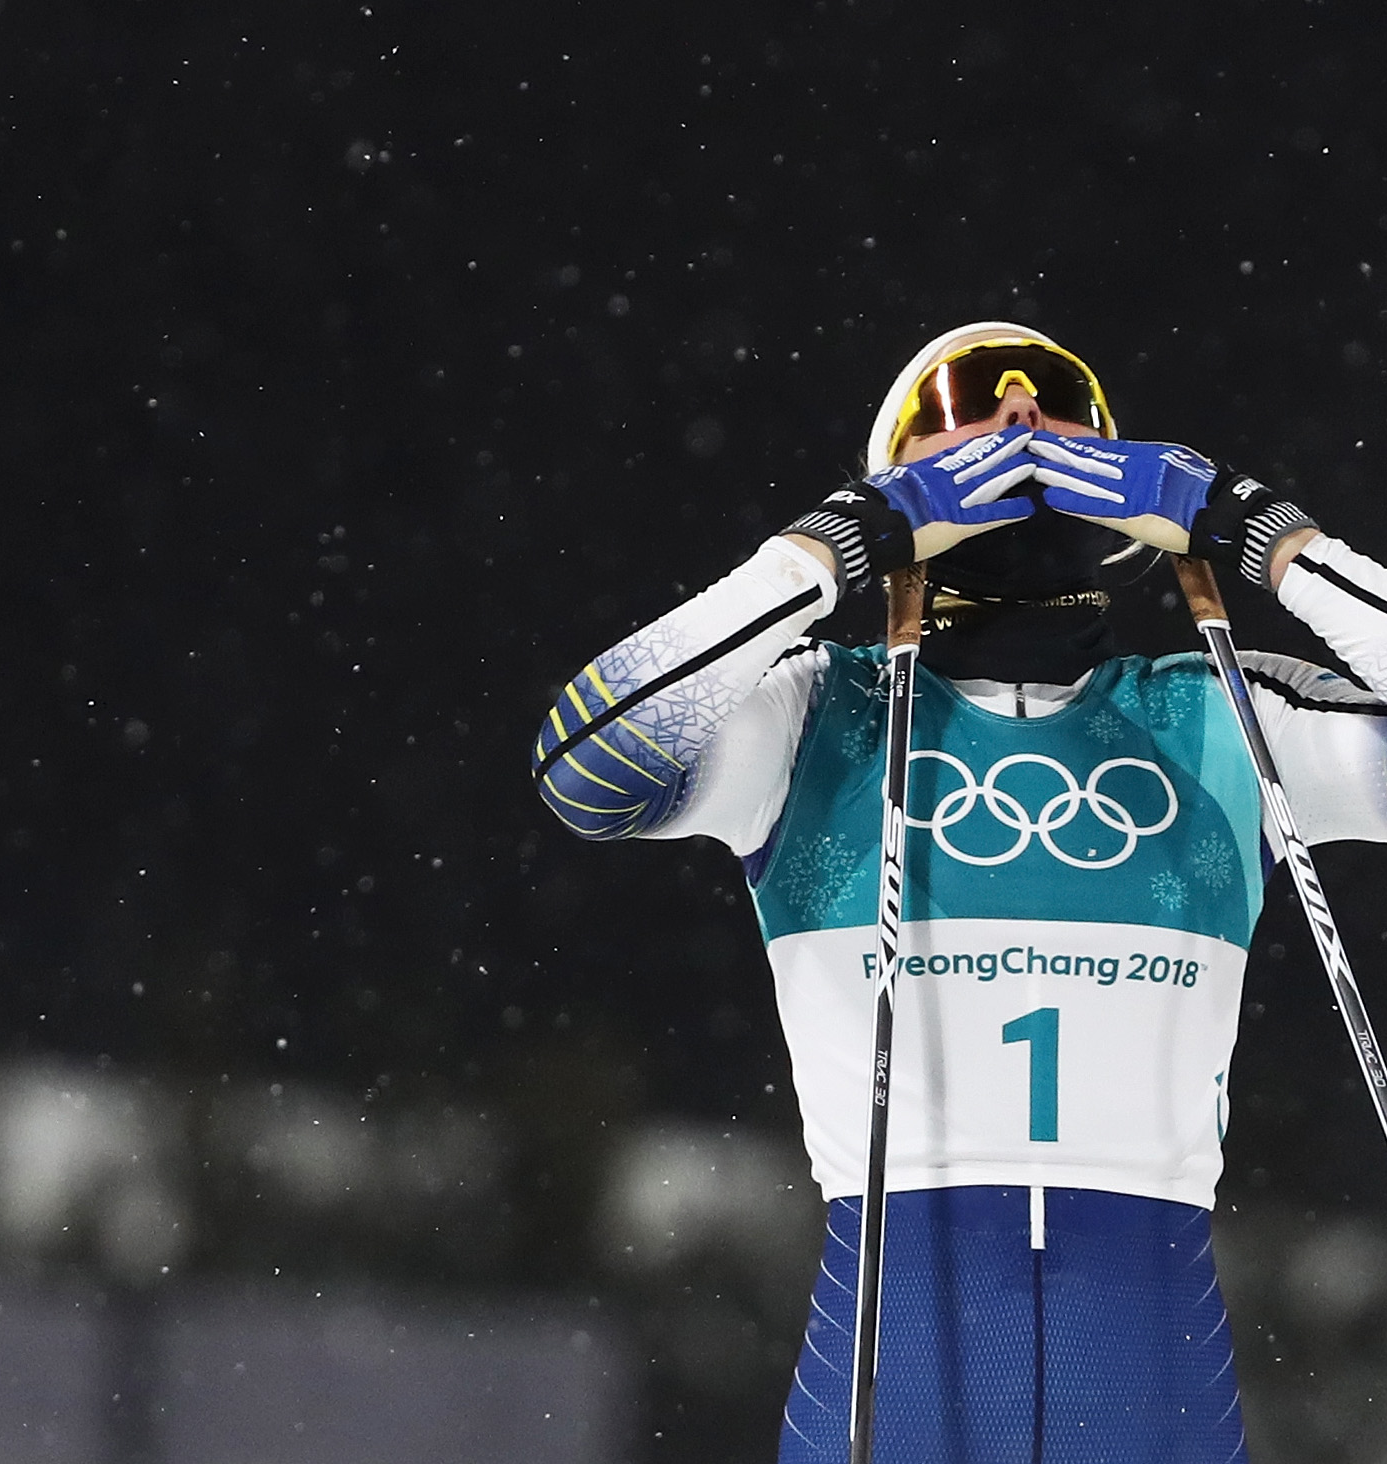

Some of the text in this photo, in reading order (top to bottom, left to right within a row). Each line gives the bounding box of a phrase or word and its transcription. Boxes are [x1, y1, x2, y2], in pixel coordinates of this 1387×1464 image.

[878, 798, 902, 1012] SWIX
[1127, 952, 1199, 989] 2018
[1263, 778, 1357, 992] SWIX
[1001, 1007, 1060, 1143] 1
